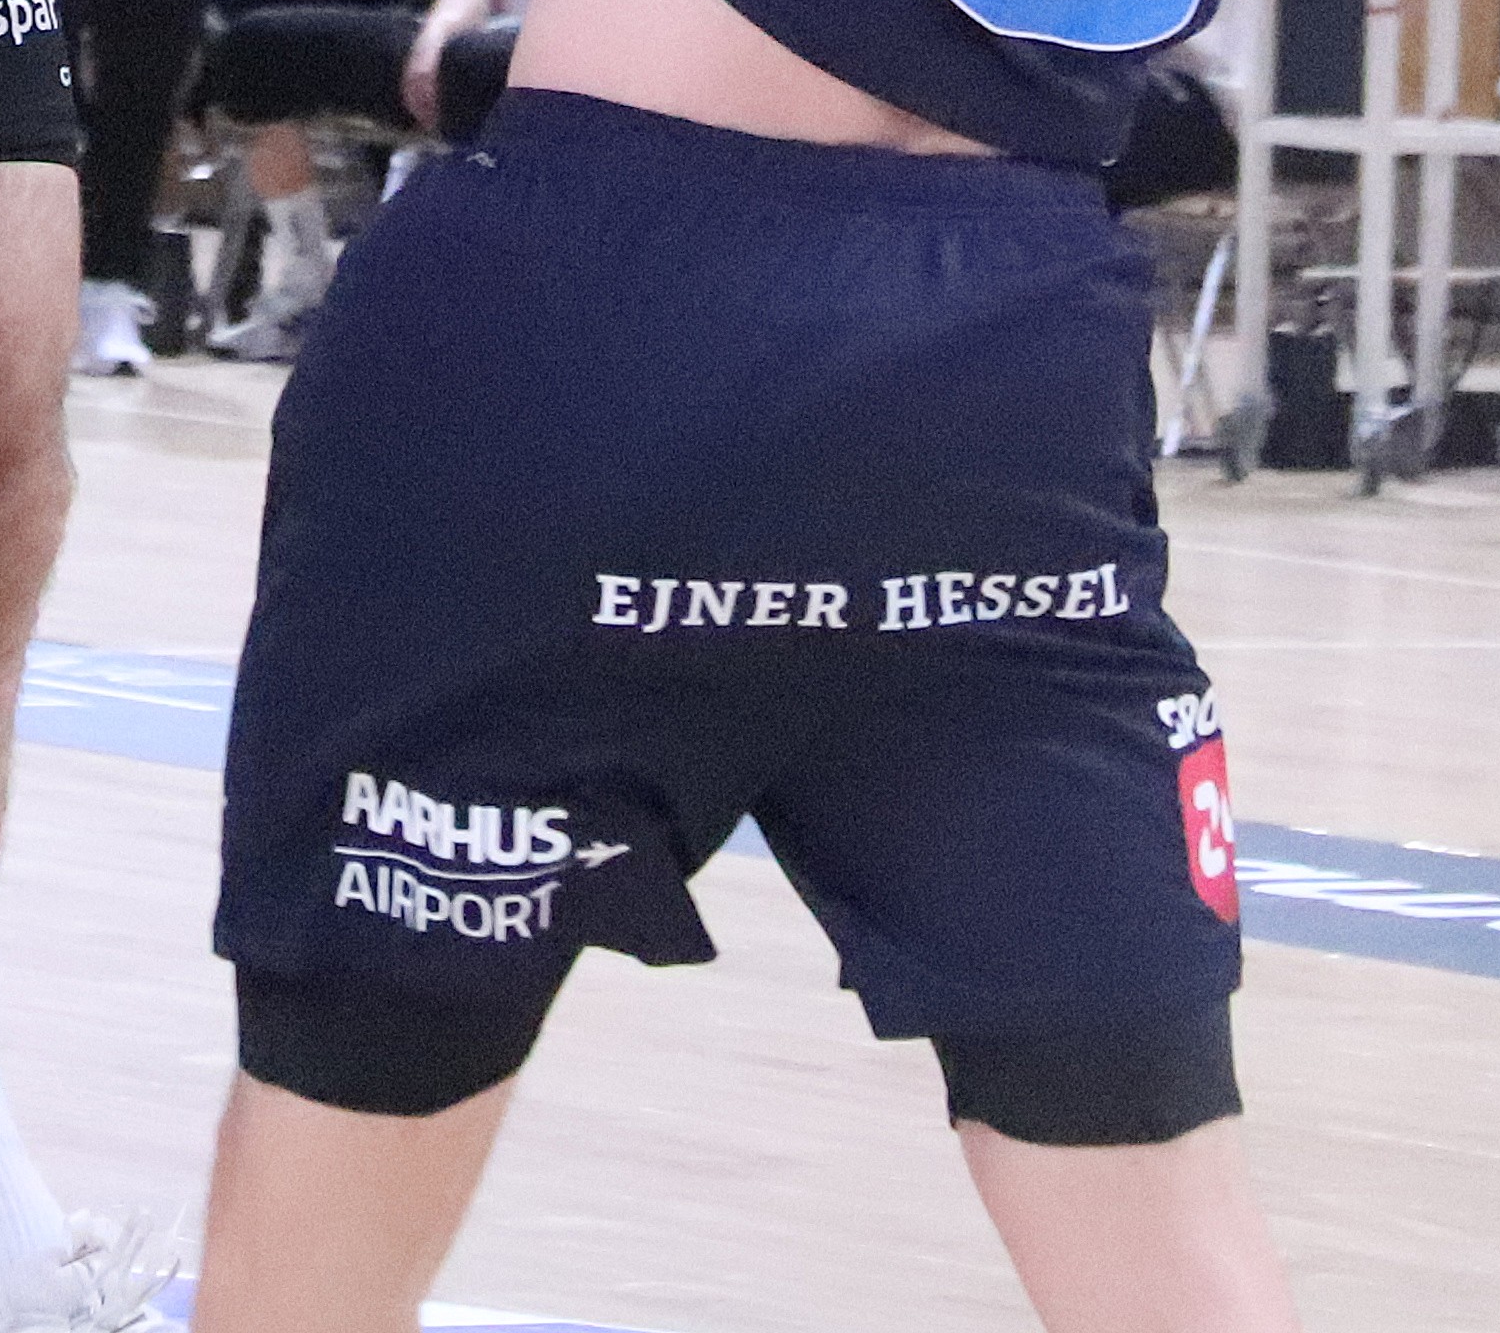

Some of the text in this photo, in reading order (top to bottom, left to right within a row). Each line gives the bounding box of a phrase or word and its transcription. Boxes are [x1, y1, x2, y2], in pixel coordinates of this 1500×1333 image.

[591, 562, 1129, 634] EJNER HESSEL
[342, 771, 572, 866] AARHUS
[334, 860, 563, 944] AIRPORT
